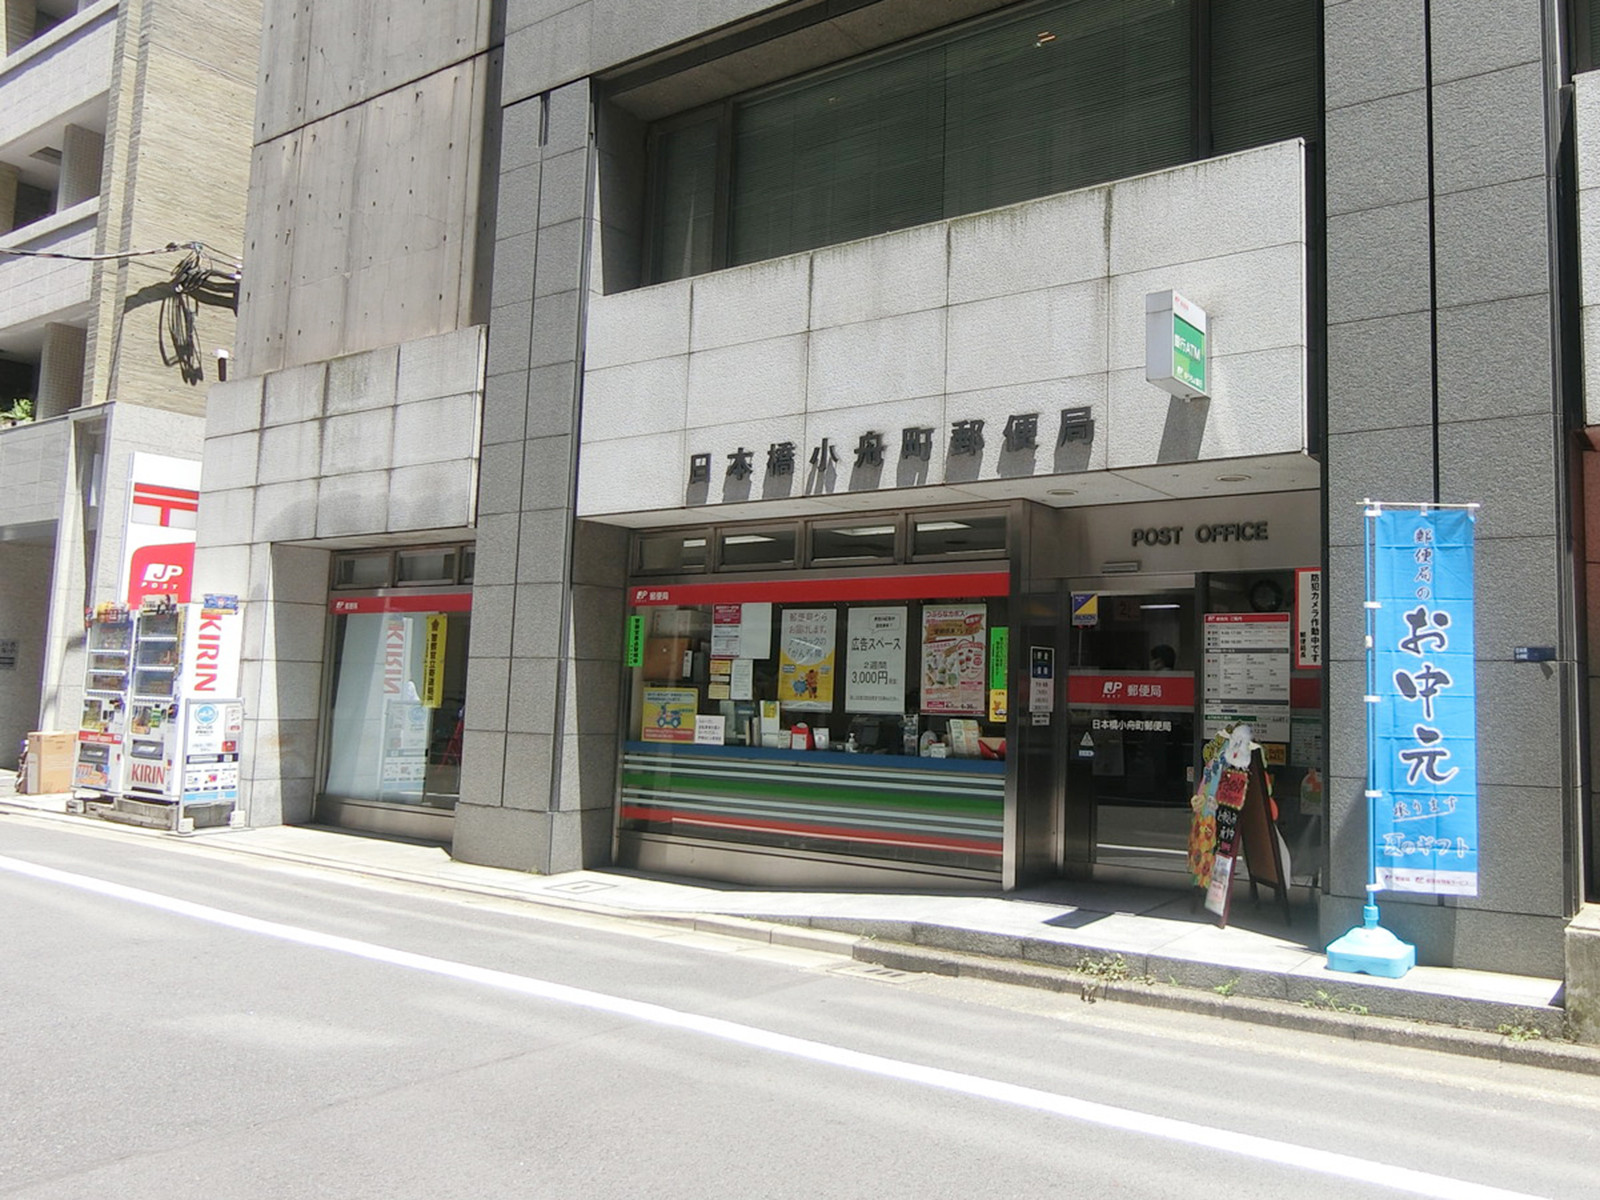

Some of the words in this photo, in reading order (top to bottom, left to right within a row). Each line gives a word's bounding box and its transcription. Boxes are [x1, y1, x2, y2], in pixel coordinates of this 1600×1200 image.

[689, 406, 1095, 484] 日本橋小舟町郵便局
[1131, 527, 1183, 547] POST
[1195, 521, 1269, 543] OFFICE
[144, 563, 184, 583] JP
[1413, 528, 1433, 601] 郵便局の
[140, 582, 179, 590] POST
[1310, 573, 1320, 663] 防犯カメラ作動中です
[194, 613, 223, 692] KIRIN
[852, 636, 902, 651] 広告スペース
[852, 670, 888, 685] 3,000円
[1103, 681, 1123, 694] JP
[1127, 684, 1162, 698] 郵便局
[1394, 605, 1460, 786] お中元
[1092, 718, 1172, 732] 日本橋小舟町郵便局
[131, 763, 165, 785] KIRIN
[1383, 832, 1470, 858] 夏のギフト
